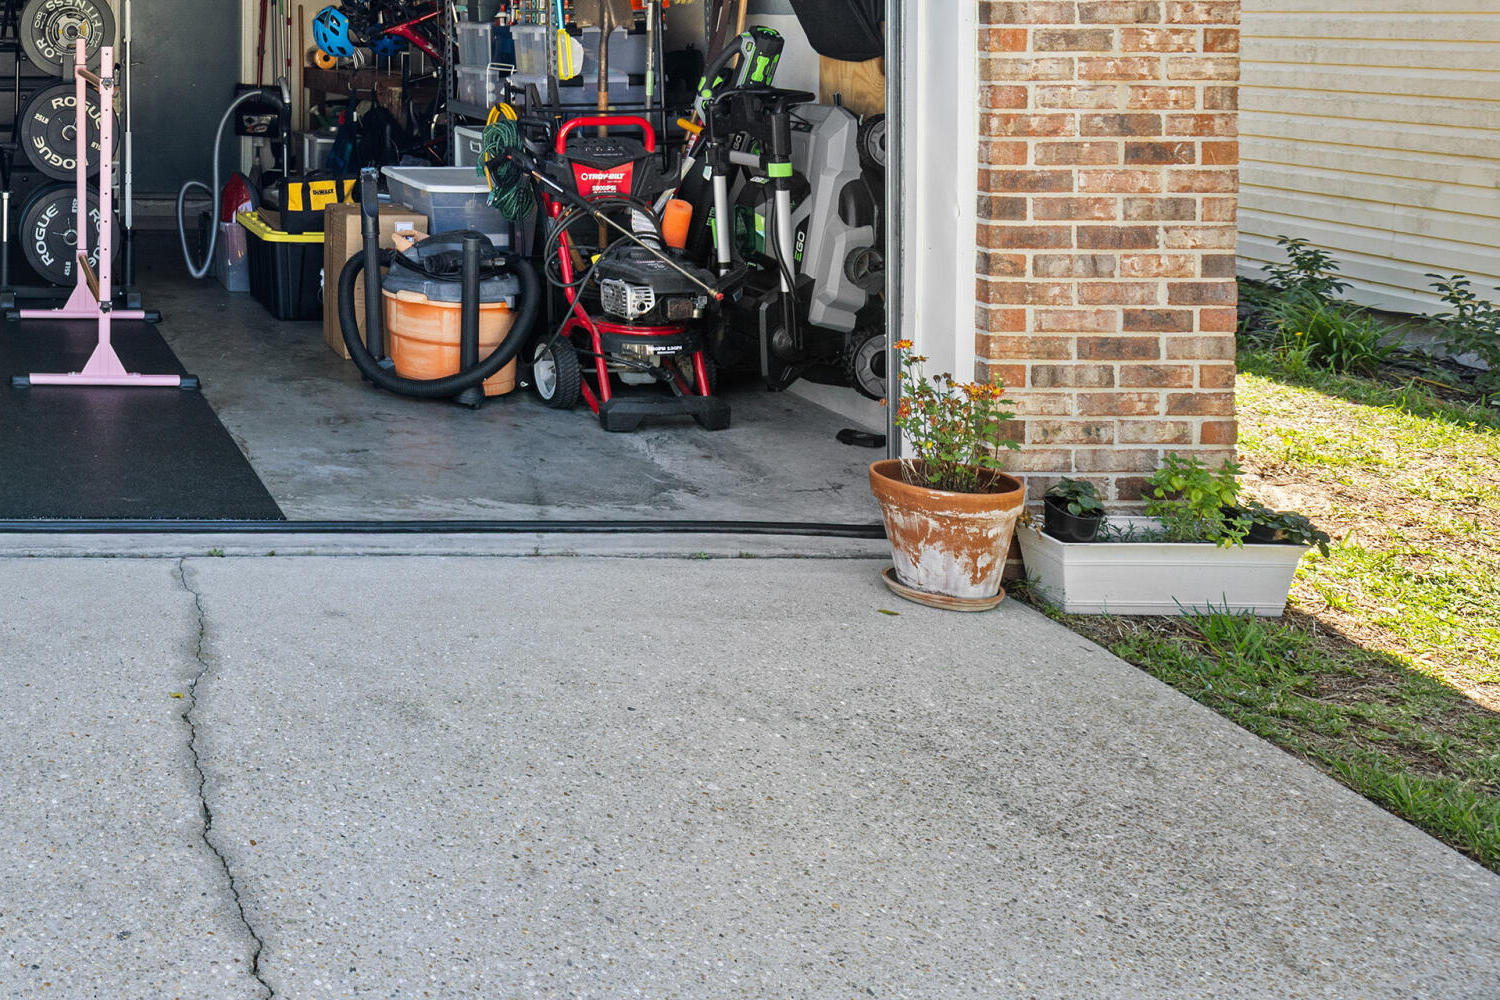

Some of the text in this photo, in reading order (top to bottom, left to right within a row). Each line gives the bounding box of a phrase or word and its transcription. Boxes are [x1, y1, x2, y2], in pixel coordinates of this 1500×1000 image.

[33, 135, 89, 170] OGUE
[35, 204, 59, 266] ROGUE
[794, 231, 805, 262] EGO
